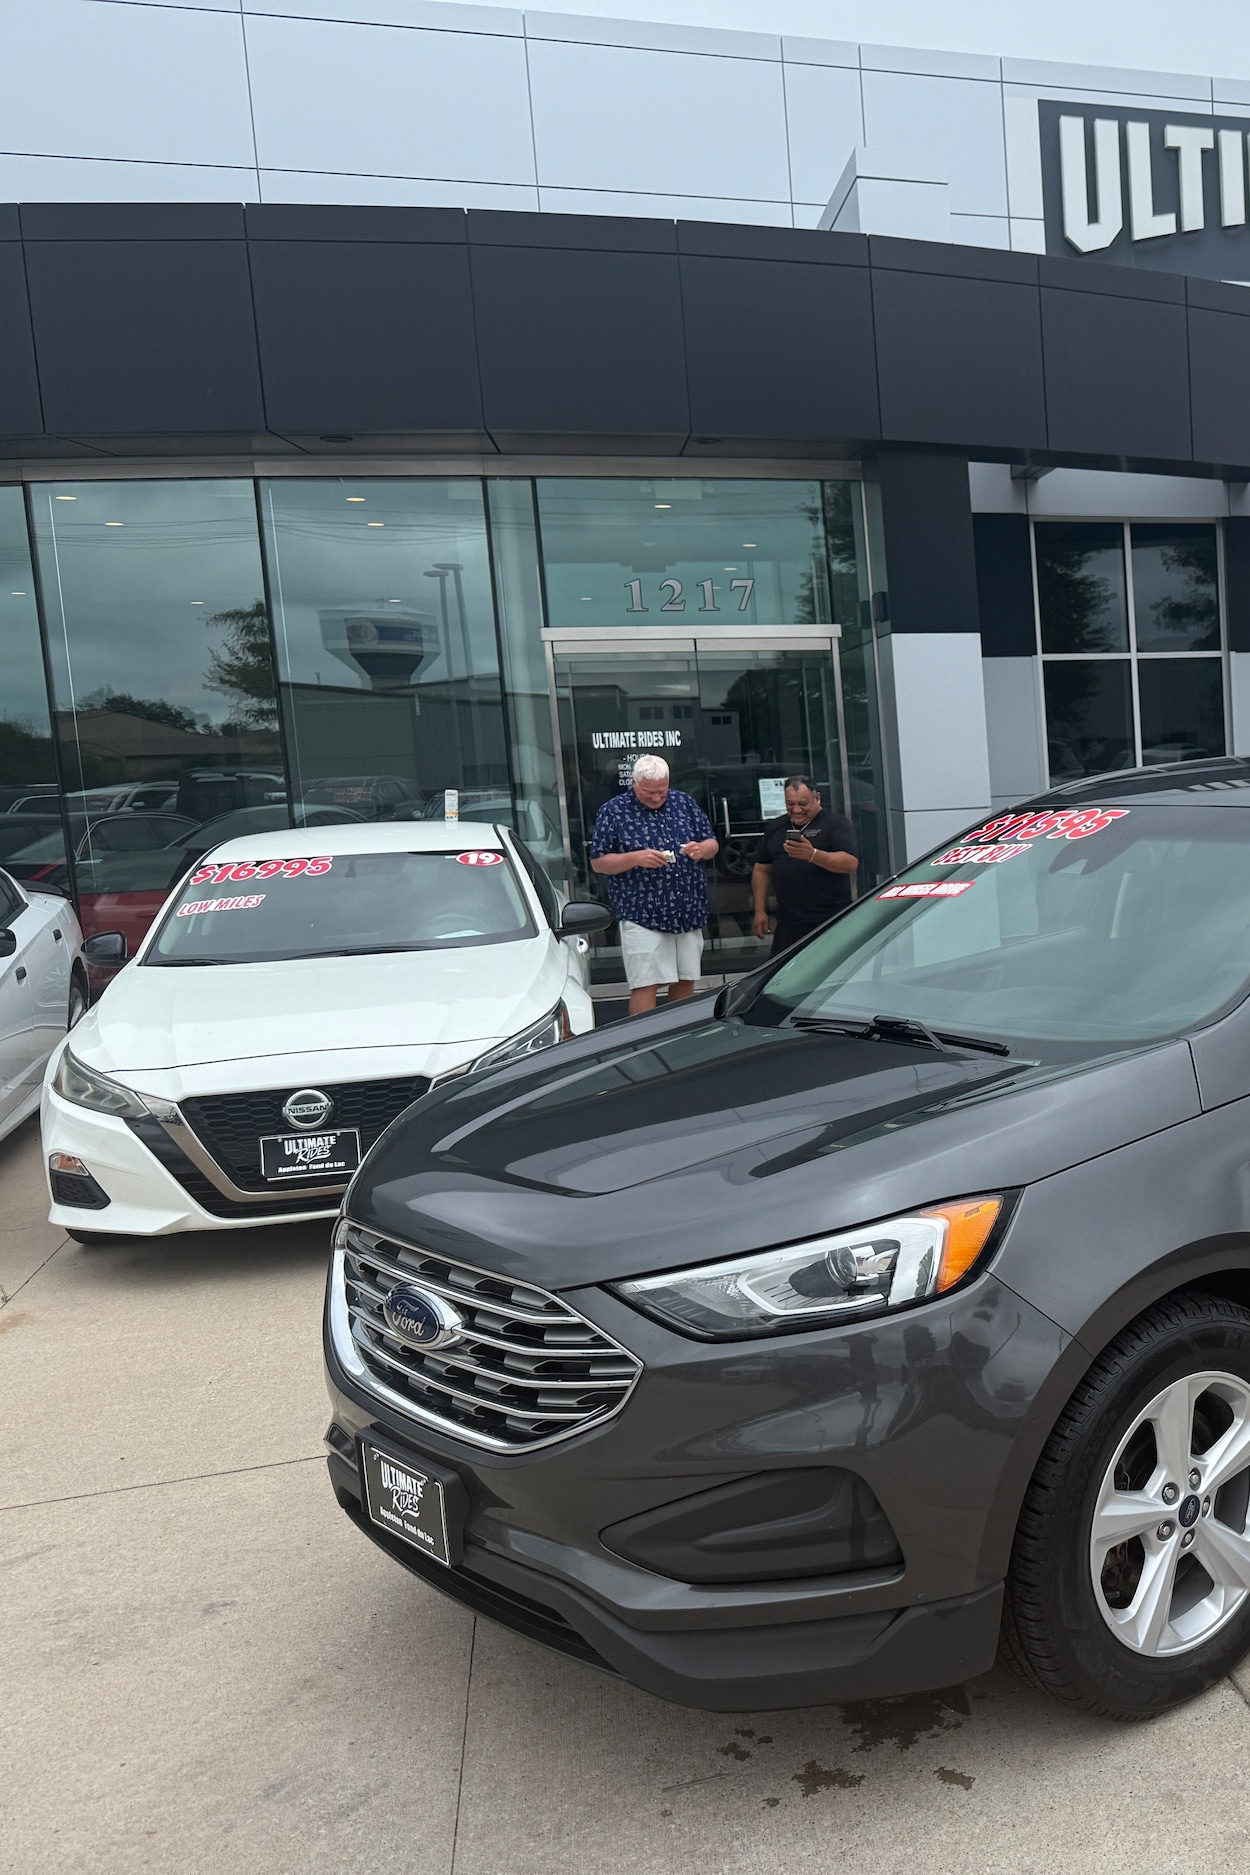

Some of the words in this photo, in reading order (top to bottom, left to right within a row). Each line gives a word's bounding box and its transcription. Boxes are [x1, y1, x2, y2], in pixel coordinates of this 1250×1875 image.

[624, 578, 755, 612] 1217
[592, 732, 637, 749] ULTIMATE
[637, 731, 664, 748] RIDES
[665, 730, 682, 747] INC
[960, 808, 1131, 843] $11595
[466, 852, 495, 865] 19
[190, 856, 333, 885] $16995
[177, 899, 216, 917] LOW
[213, 894, 266, 912] MILES
[288, 1104, 328, 1115] NISSAN
[284, 1135, 337, 1156] ULTIMATE
[278, 1164, 307, 1173] Appleton
[392, 1299, 426, 1337] Ford
[380, 1460, 424, 1498] ULTIMATE
